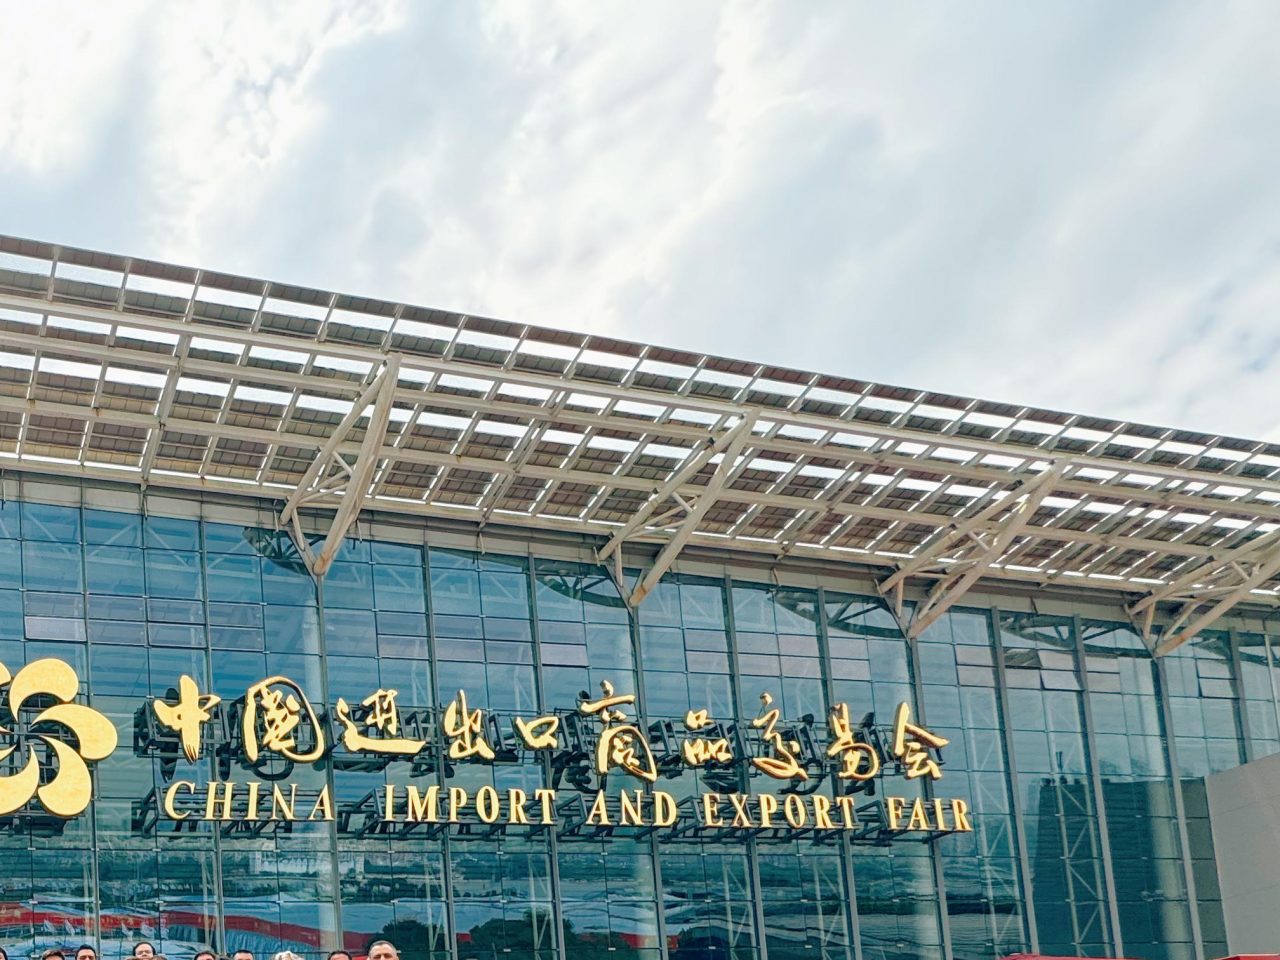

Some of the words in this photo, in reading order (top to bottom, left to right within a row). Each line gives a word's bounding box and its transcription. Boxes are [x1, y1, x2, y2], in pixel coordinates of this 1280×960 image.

[164, 780, 335, 821] CHINA
[382, 784, 556, 826] IMPORT
[585, 789, 678, 827] AND
[702, 792, 855, 830] EXPORT
[886, 796, 972, 832] FAIR
